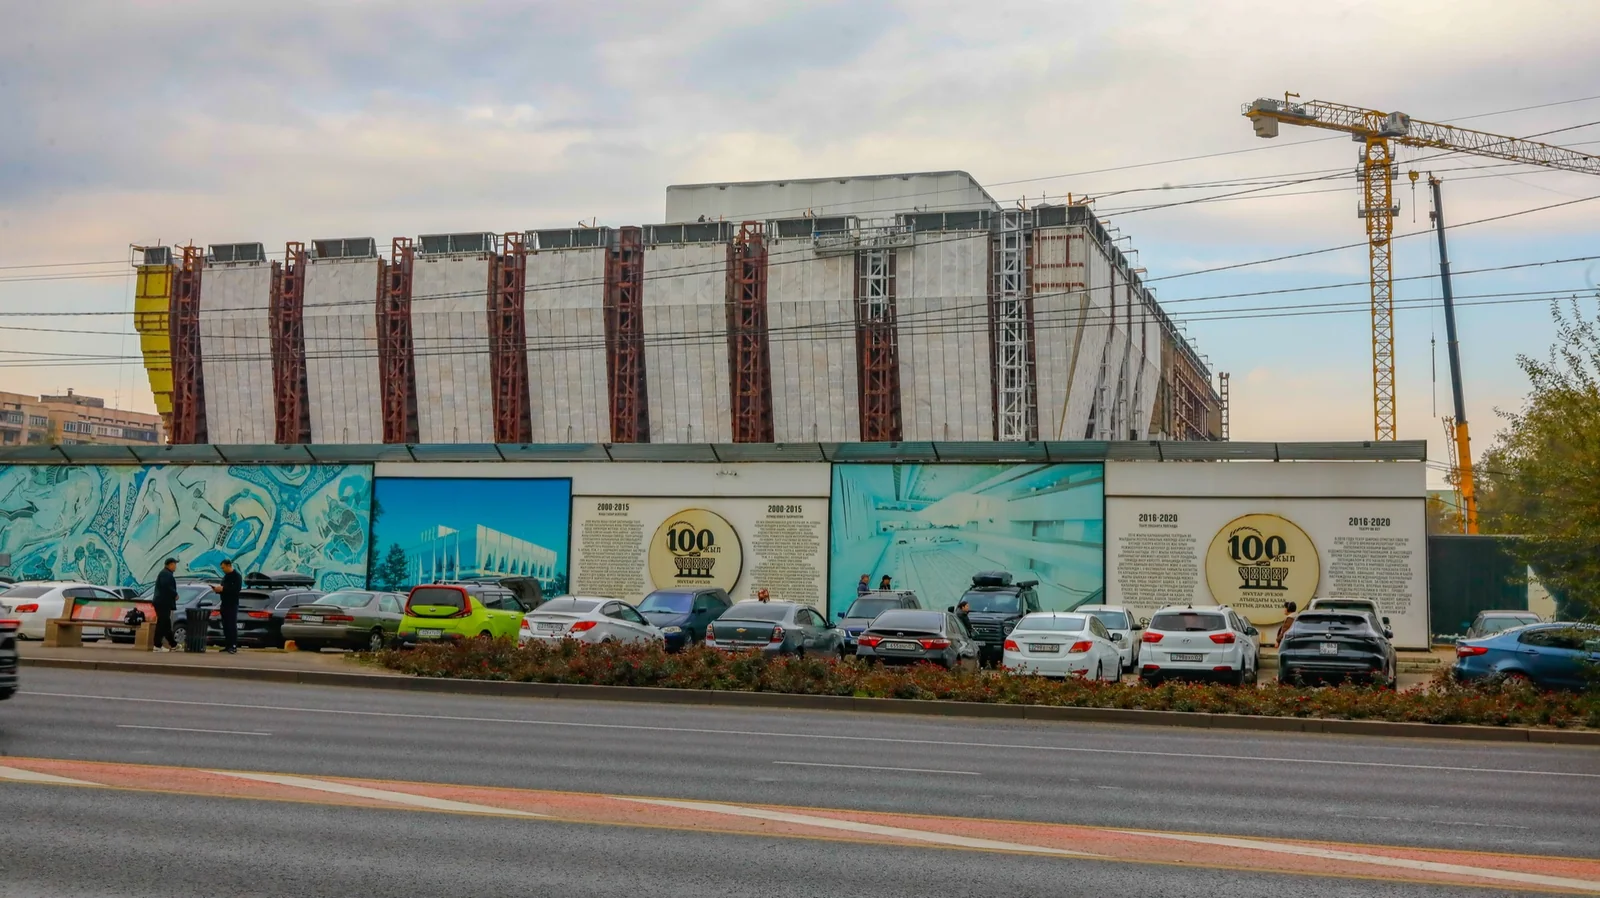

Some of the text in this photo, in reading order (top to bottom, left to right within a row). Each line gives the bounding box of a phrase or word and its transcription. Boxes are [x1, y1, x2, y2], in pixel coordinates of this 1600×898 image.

[1139, 513, 1178, 522] 2016-2020
[1348, 517, 1391, 527] 2016-2020
[666, 529, 714, 552] 100
[1228, 535, 1286, 560] 100
